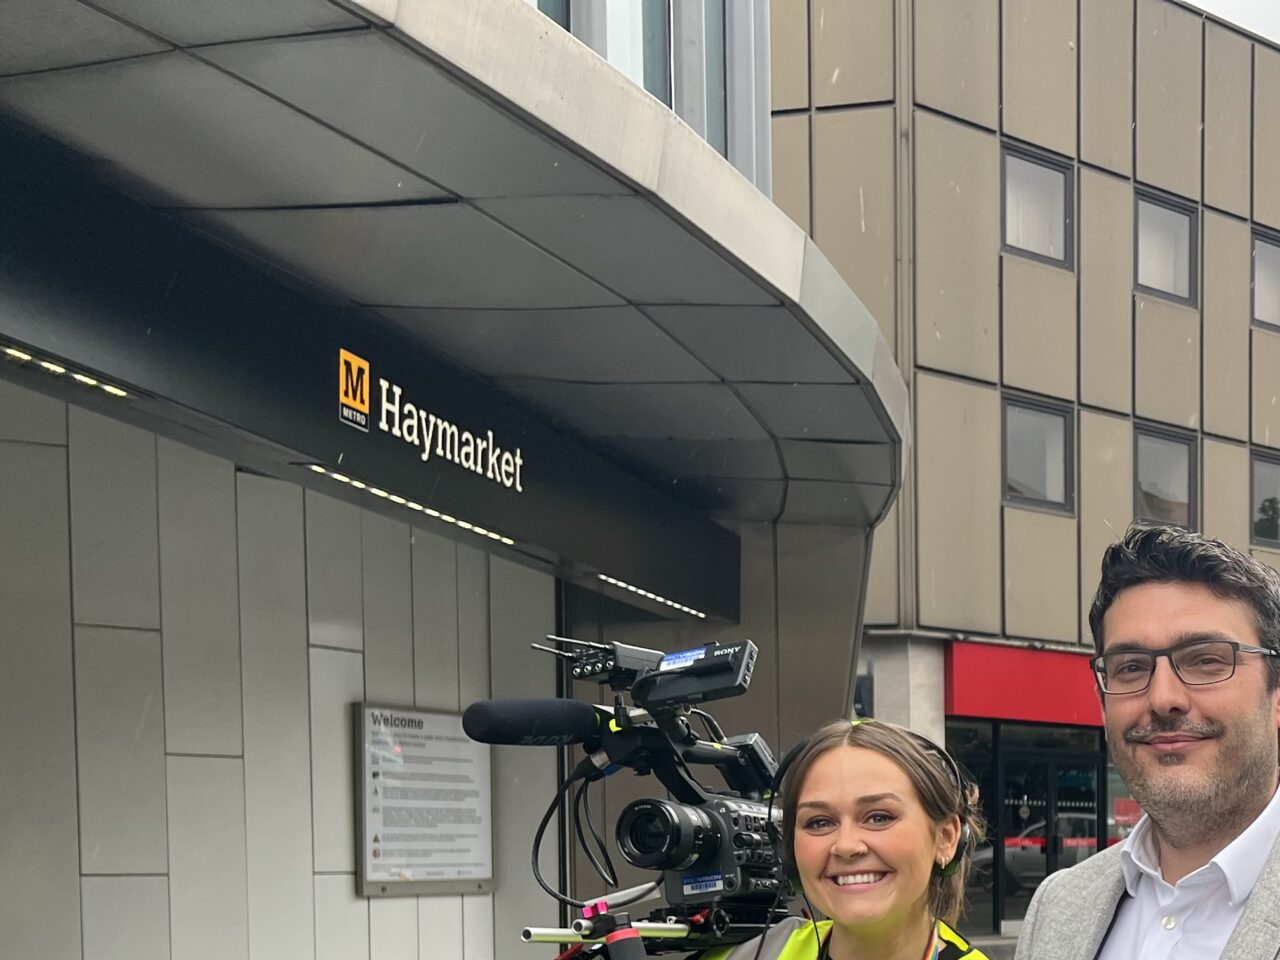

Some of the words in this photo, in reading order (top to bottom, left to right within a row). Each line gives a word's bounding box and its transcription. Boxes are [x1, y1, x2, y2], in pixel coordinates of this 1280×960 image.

[344, 360, 366, 405] M
[342, 406, 367, 425] METRO
[379, 378, 523, 492] Haymarket
[713, 646, 741, 657] SONY
[371, 711, 425, 731] Welcome
